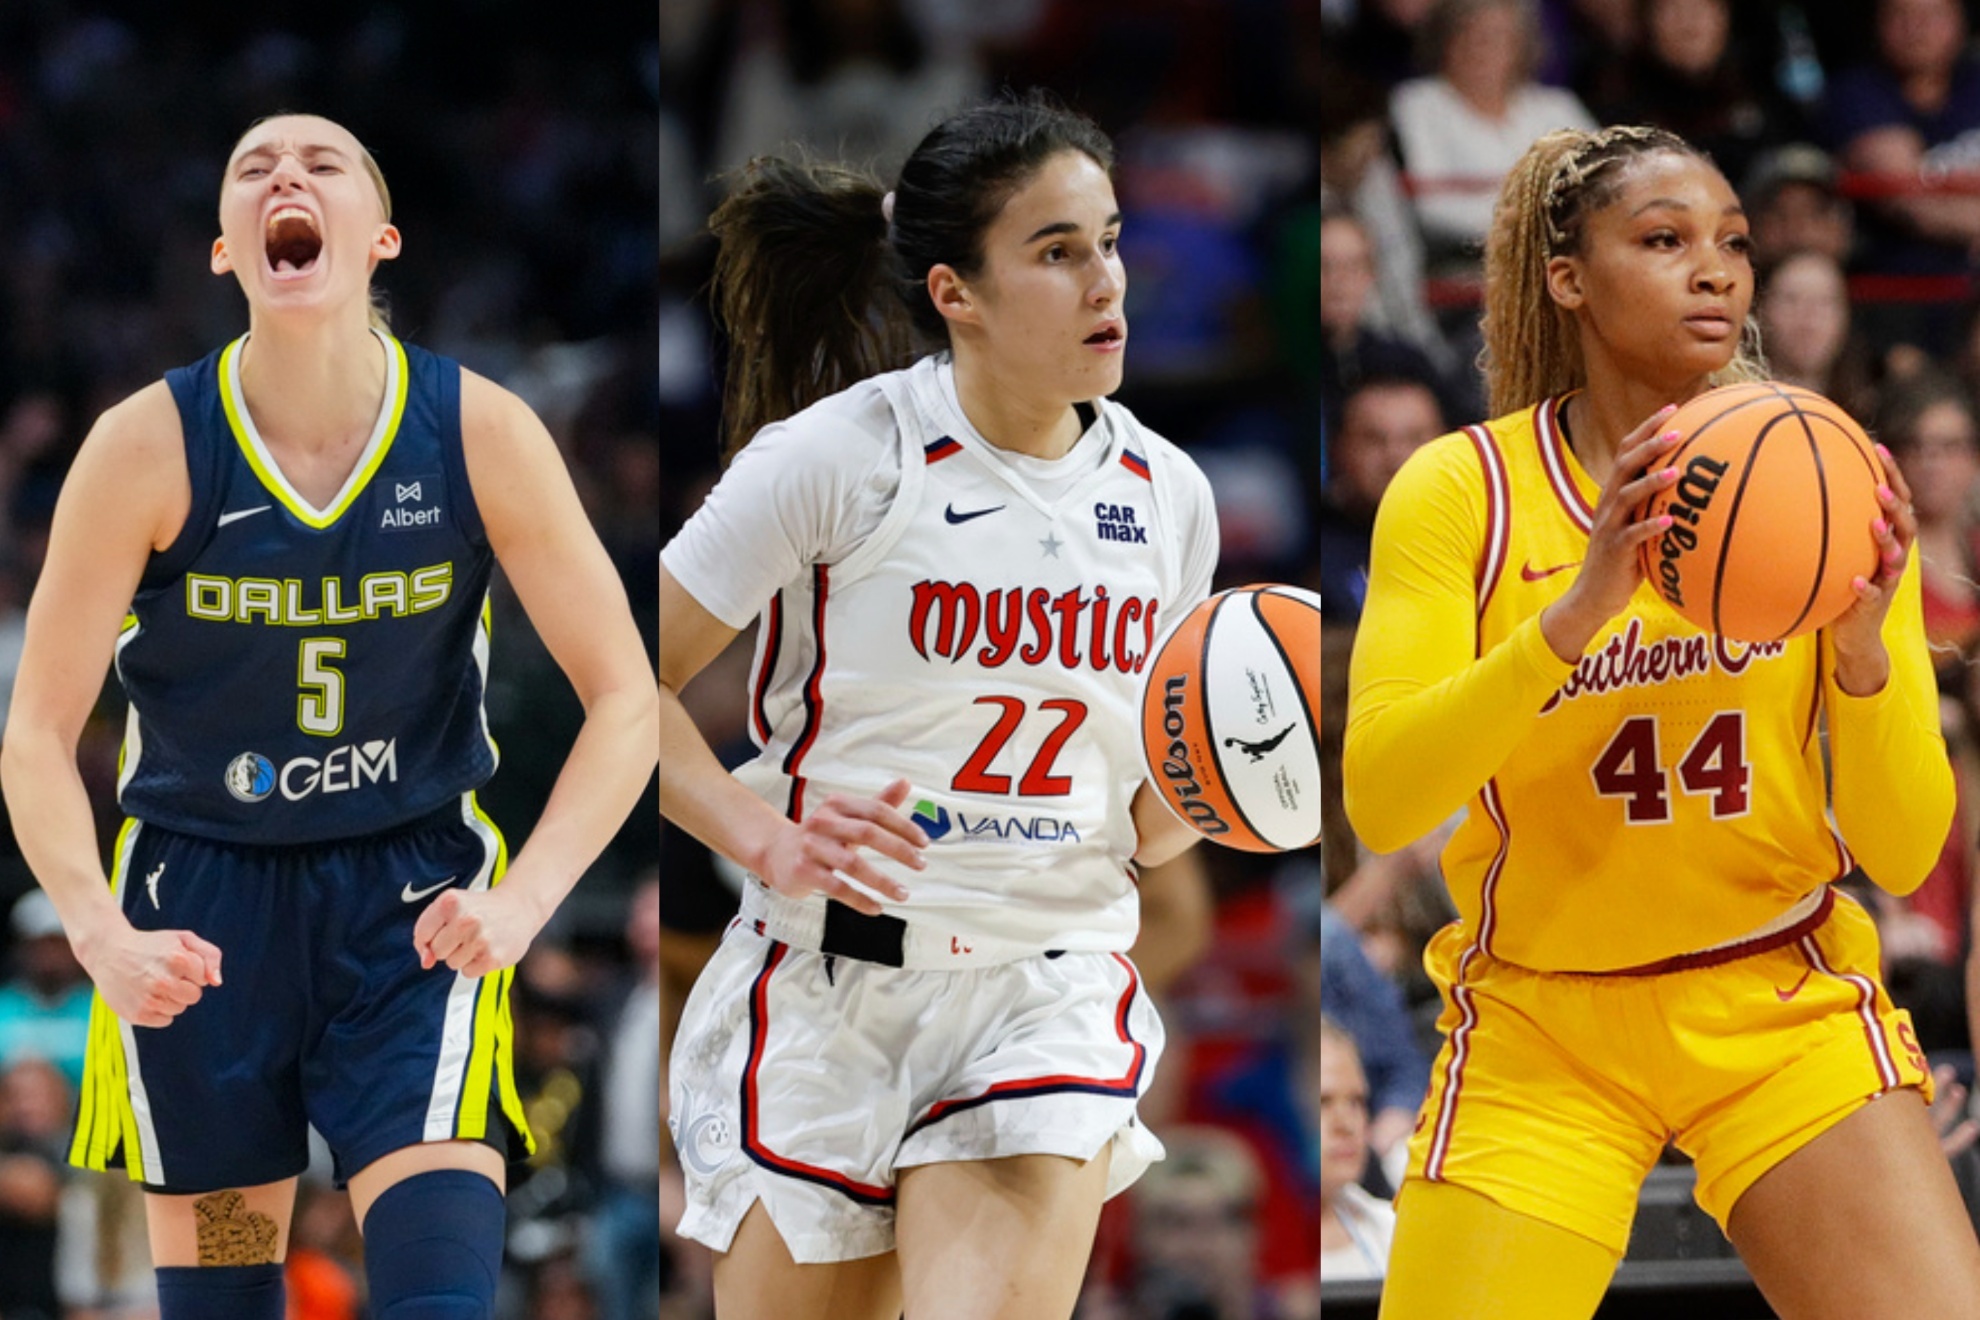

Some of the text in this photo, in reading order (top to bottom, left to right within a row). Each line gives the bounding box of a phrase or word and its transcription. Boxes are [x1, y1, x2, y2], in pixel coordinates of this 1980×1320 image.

[380, 506, 441, 528] Albert
[1094, 502, 1135, 524] CAR
[1097, 521, 1148, 545] max
[1659, 454, 1730, 608] Wilson
[186, 561, 452, 626] DALLAS
[297, 637, 346, 738] 5
[279, 737, 398, 801] GEM
[951, 695, 1088, 797] 22
[1163, 673, 1231, 836] Wilson
[1590, 709, 1753, 825] 44
[957, 813, 1081, 843] VANDA
